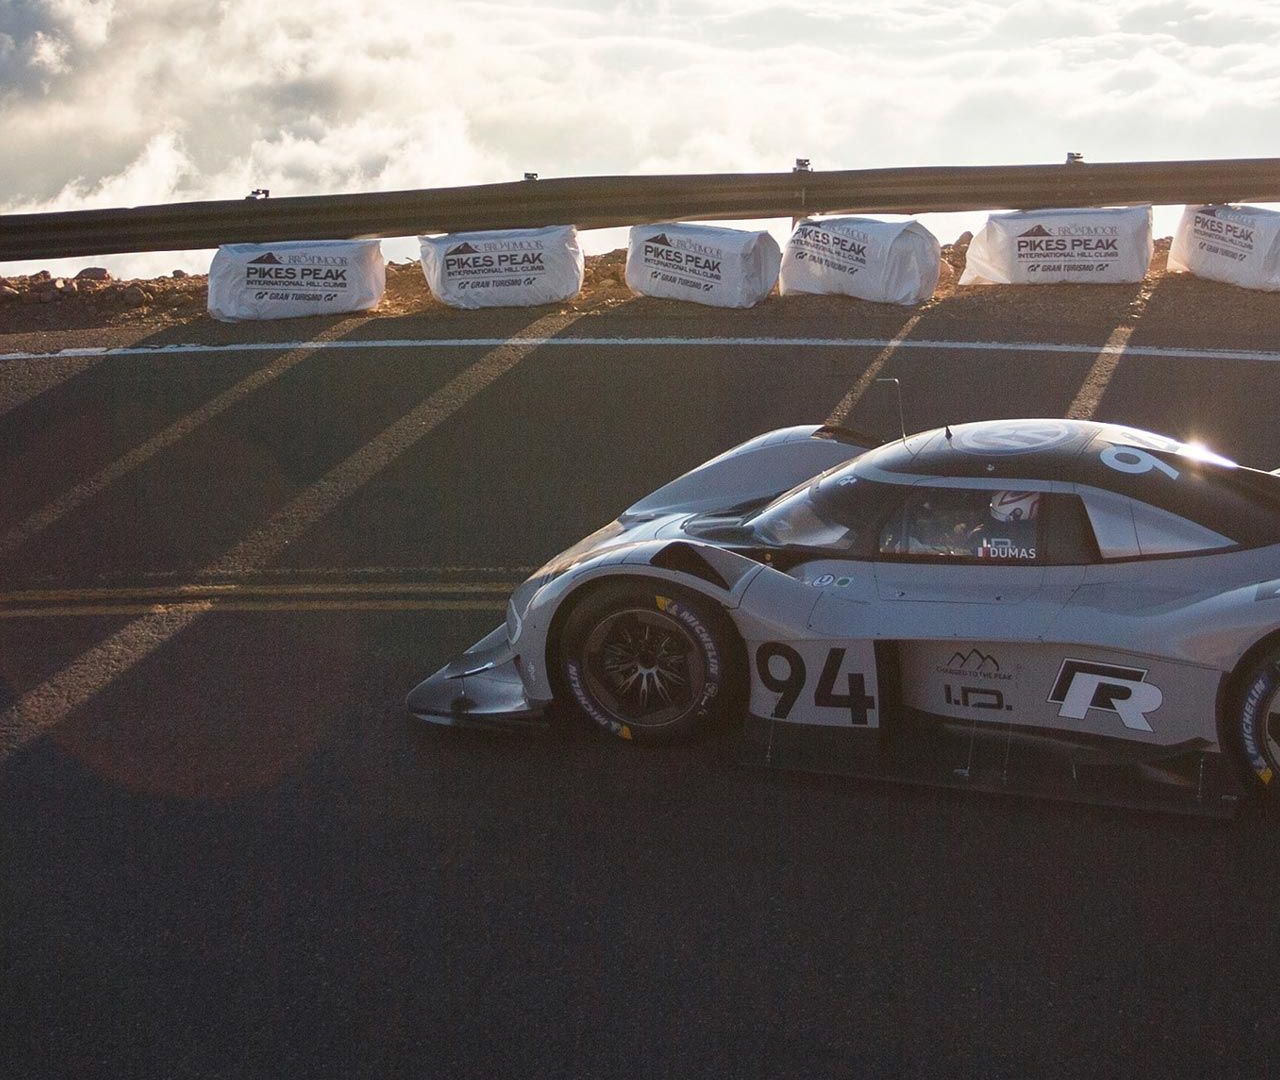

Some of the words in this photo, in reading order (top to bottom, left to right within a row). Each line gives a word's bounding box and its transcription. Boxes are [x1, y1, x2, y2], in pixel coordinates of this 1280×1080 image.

[795, 228, 829, 244] PIKES
[833, 237, 866, 257] PEAK
[1194, 216, 1223, 233] PIKES
[1226, 224, 1253, 242] PEAK
[1018, 240, 1066, 251] PIKES
[1072, 239, 1118, 250] PEAK
[446, 256, 494, 269] PIKES
[498, 253, 543, 265] PEAK
[645, 245, 682, 262] PIKES
[686, 255, 721, 273] PEAK
[247, 267, 296, 278] PIKES
[301, 268, 346, 280] PEAK
[471, 281, 490, 289] GRAN
[492, 279, 521, 287] TURISMO
[990, 547, 1037, 559] DUMAS
[679, 610, 719, 677] MICHELIN
[568, 664, 609, 726] MICHELIN
[756, 641, 875, 725] 94
[944, 684, 1013, 711] I.D.
[1056, 668, 1163, 733] R
[1241, 678, 1267, 755] MICHELIN
